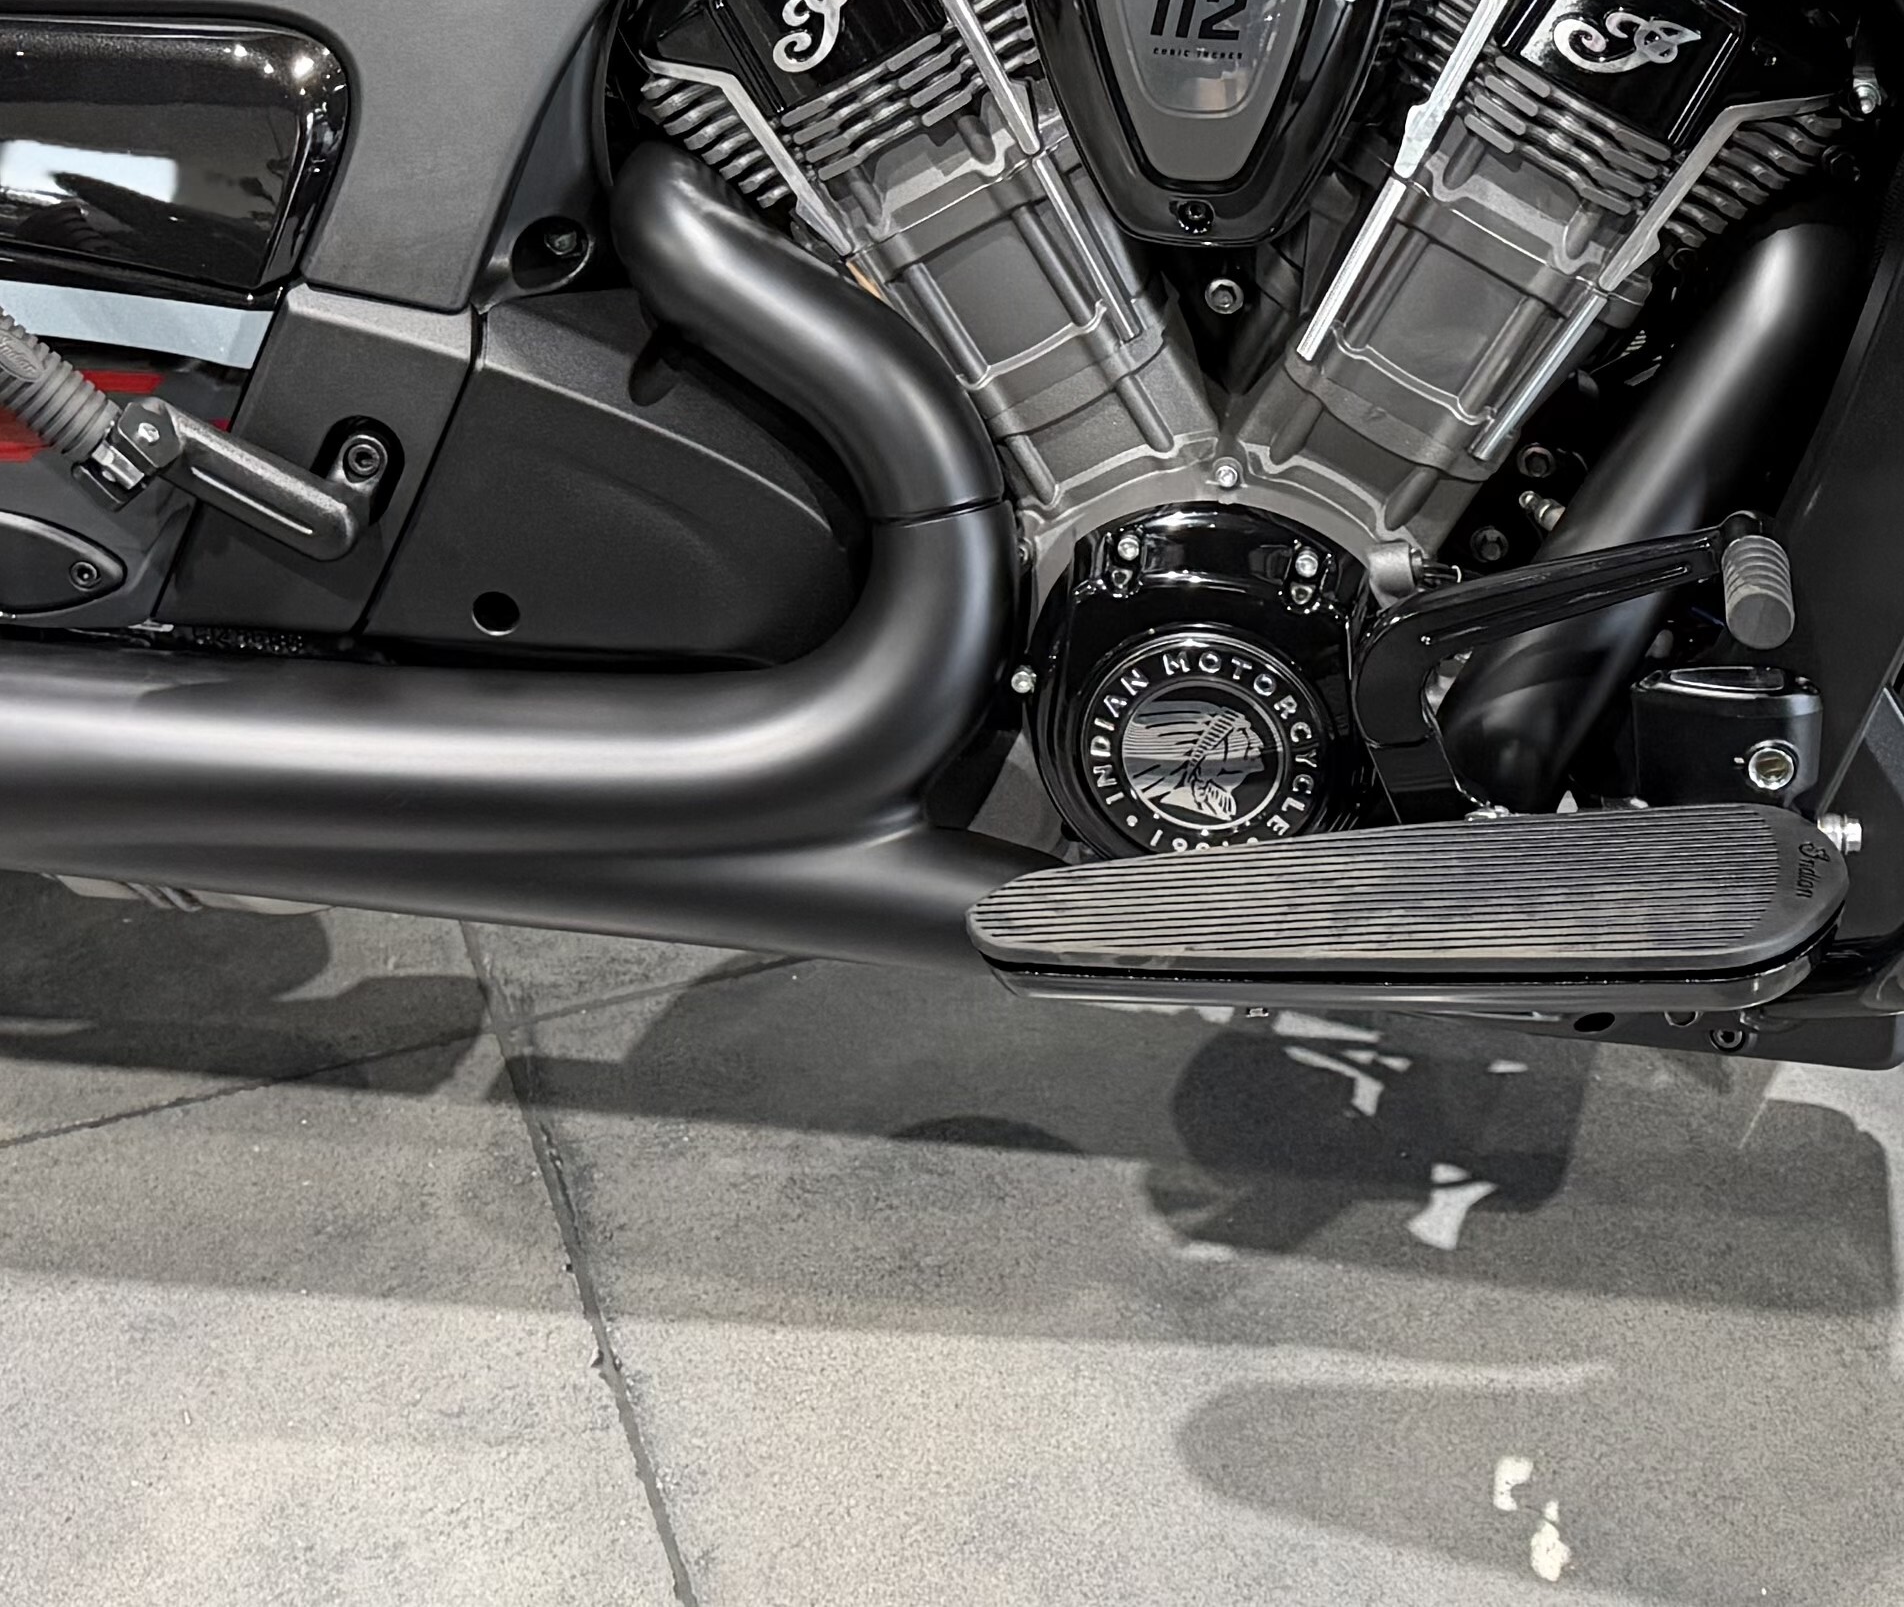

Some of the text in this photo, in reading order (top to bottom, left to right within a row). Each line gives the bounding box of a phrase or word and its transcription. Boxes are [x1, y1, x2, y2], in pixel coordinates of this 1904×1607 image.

[1090, 650, 1318, 837] INDIAN MOTORCYCLE
[1796, 842, 1830, 898] Indian
